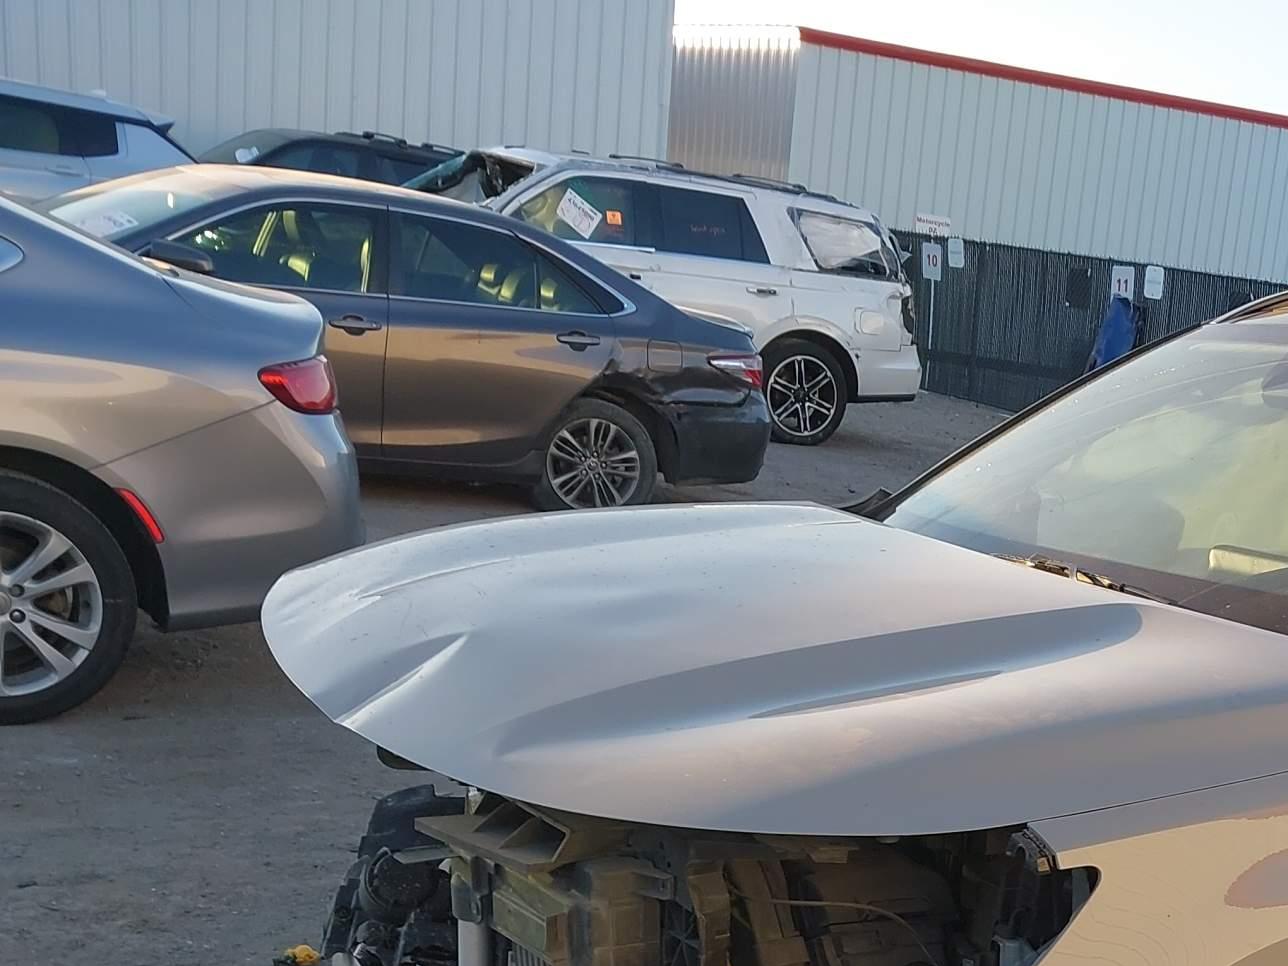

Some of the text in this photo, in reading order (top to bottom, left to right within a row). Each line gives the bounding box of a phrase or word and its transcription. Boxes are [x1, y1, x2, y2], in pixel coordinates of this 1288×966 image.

[916, 216, 951, 227] Motorcycle
[927, 254, 938, 267] 10
[1116, 278, 1128, 293] 11
